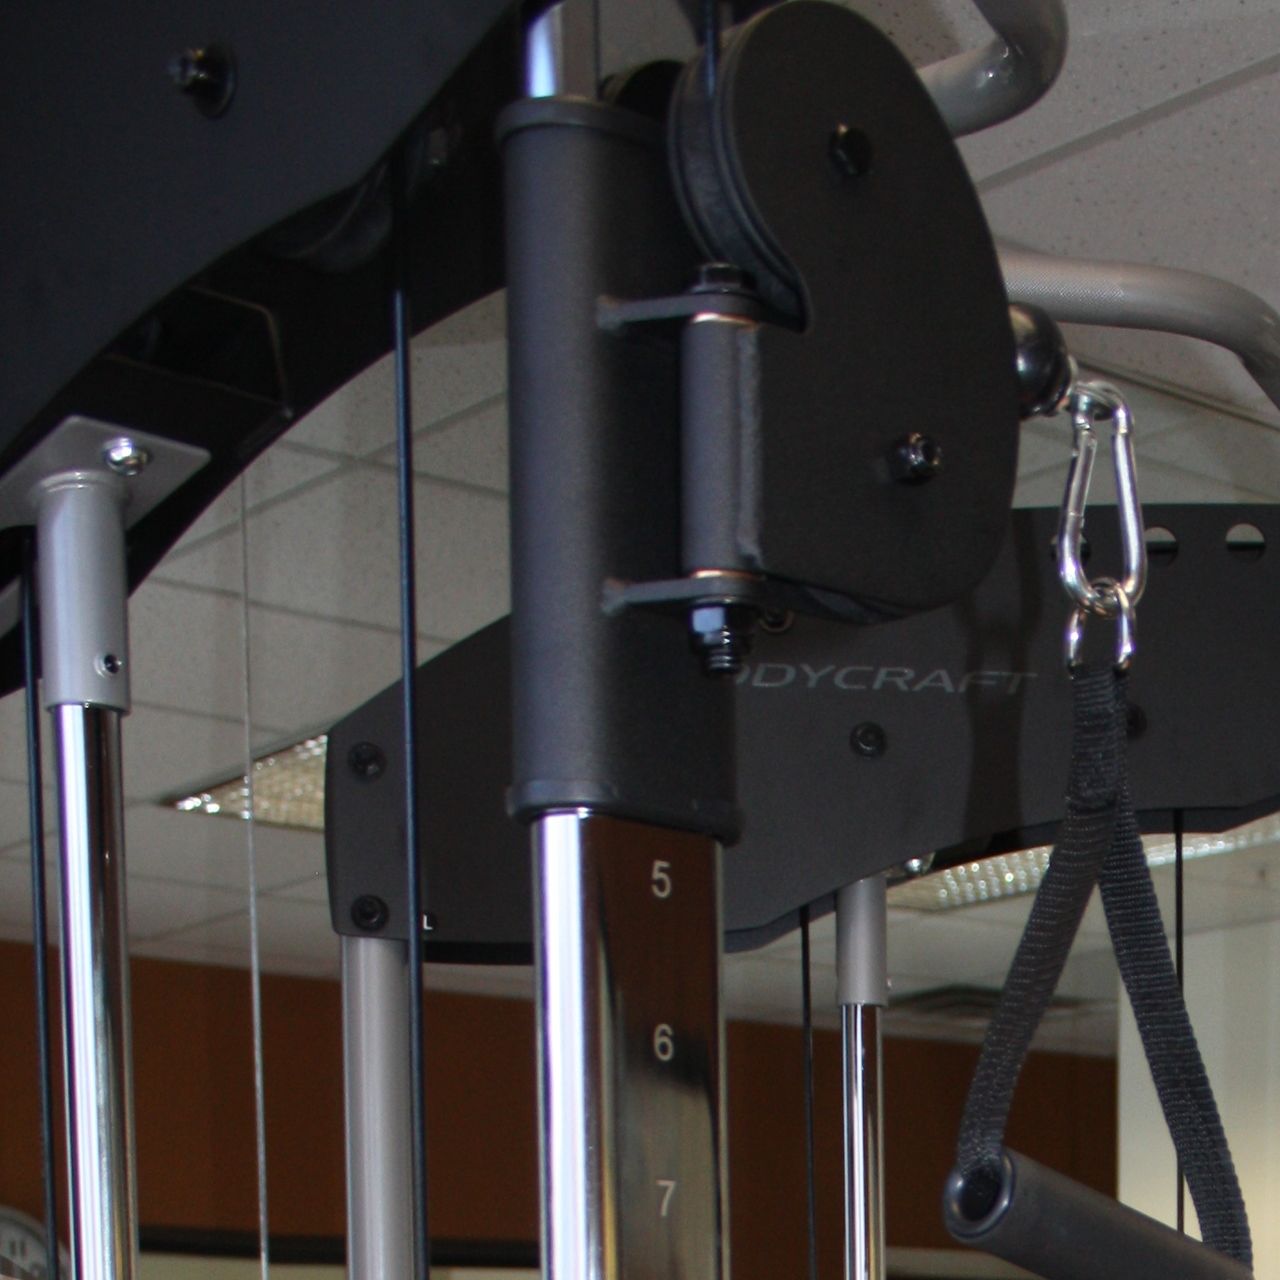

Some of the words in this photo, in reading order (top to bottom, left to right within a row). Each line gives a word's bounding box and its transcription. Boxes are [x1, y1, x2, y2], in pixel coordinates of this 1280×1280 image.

[735, 663, 1038, 695] DYCRAFT
[652, 860, 671, 898] 5
[653, 1023, 674, 1061] 6
[656, 1179, 676, 1217] 7
